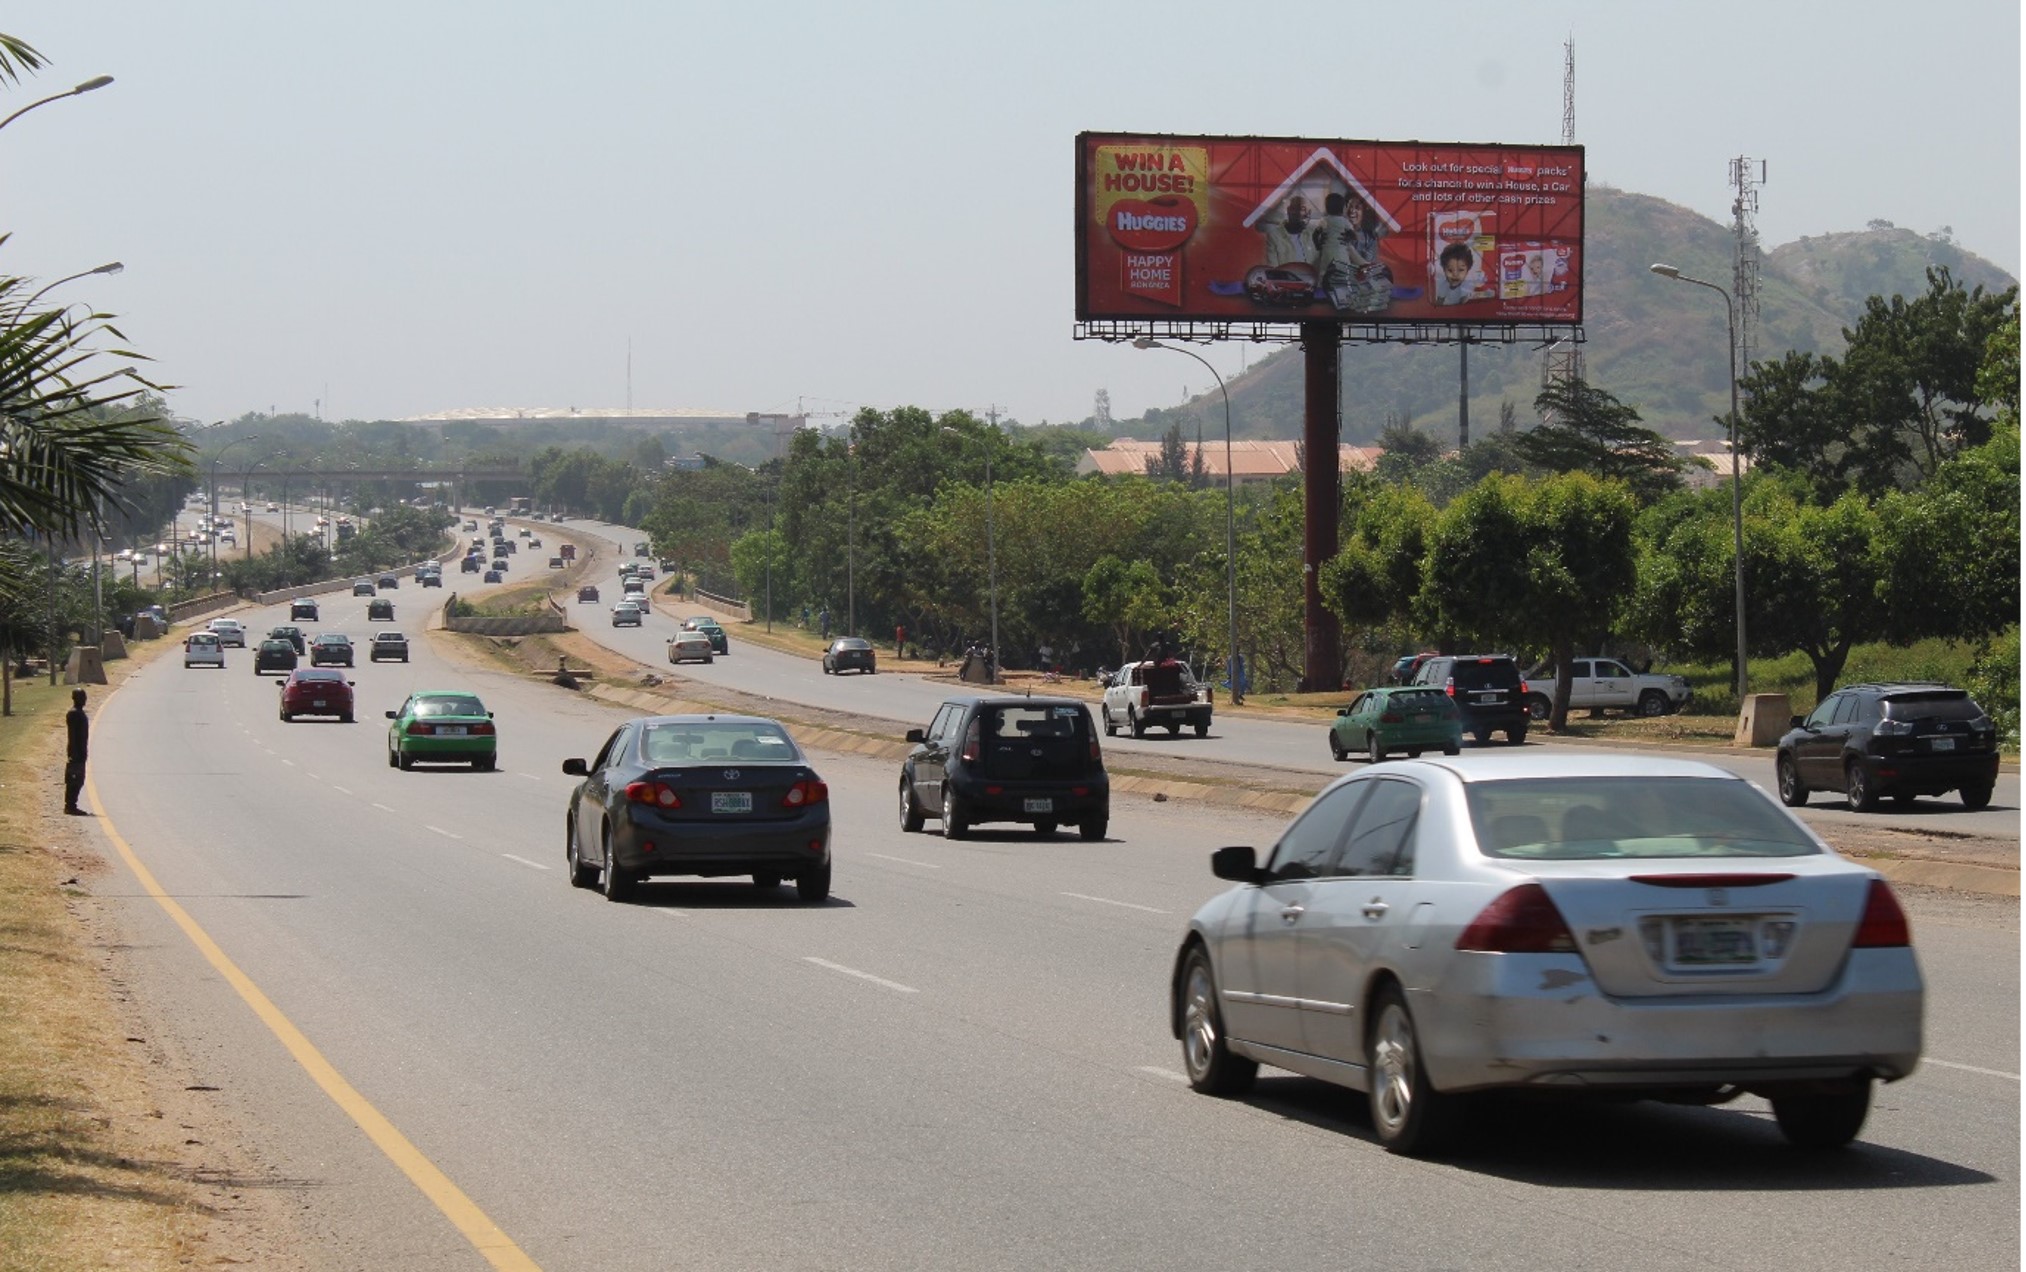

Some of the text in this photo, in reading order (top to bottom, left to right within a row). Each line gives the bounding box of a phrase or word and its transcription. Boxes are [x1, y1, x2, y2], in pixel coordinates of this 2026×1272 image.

[1115, 153, 1185, 172] WIN A
[1402, 161, 1428, 172] Look
[1430, 162, 1447, 172] out
[1449, 162, 1464, 172] for
[1466, 164, 1503, 175] special
[1536, 166, 1568, 177] packs
[1105, 174, 1194, 193] HOUSE!
[1424, 178, 1462, 188] chance
[1464, 179, 1474, 188] to
[1476, 179, 1494, 189] win
[1505, 180, 1540, 191] House,
[1551, 181, 1570, 191] Car
[1412, 191, 1556, 205] and lots of other cash prizes
[1127, 255, 1173, 267] HAPPY
[1130, 268, 1171, 281] HOME
